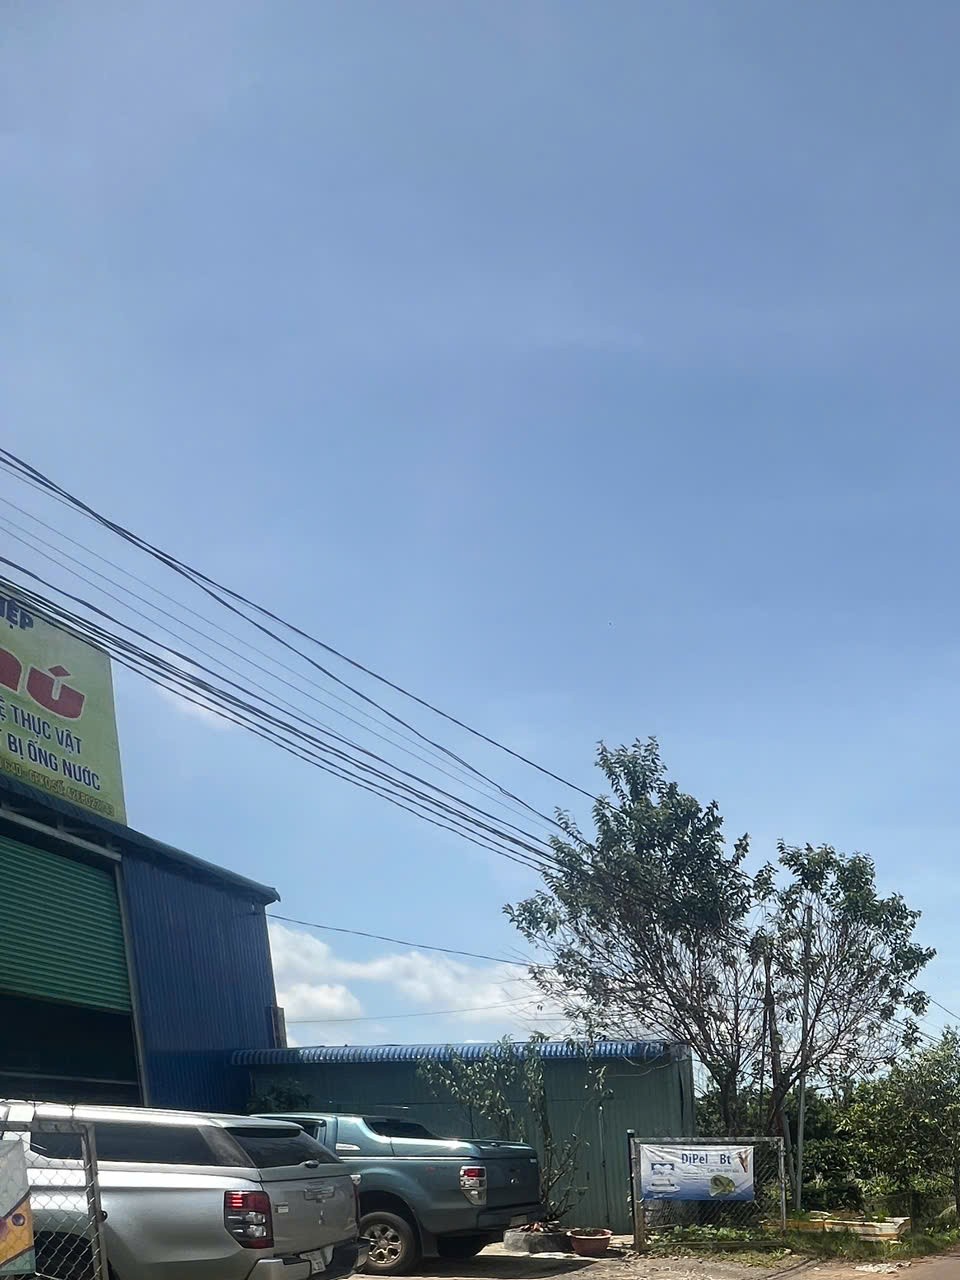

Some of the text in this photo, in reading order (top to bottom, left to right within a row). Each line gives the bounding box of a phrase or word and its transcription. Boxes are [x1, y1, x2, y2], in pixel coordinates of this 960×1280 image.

[10, 704, 51, 740] THỰC
[55, 727, 82, 754] VẬT
[8, 733, 100, 791] BỊ ỐNG NƯỚC
[681, 1153, 731, 1165] DiPel Bt
